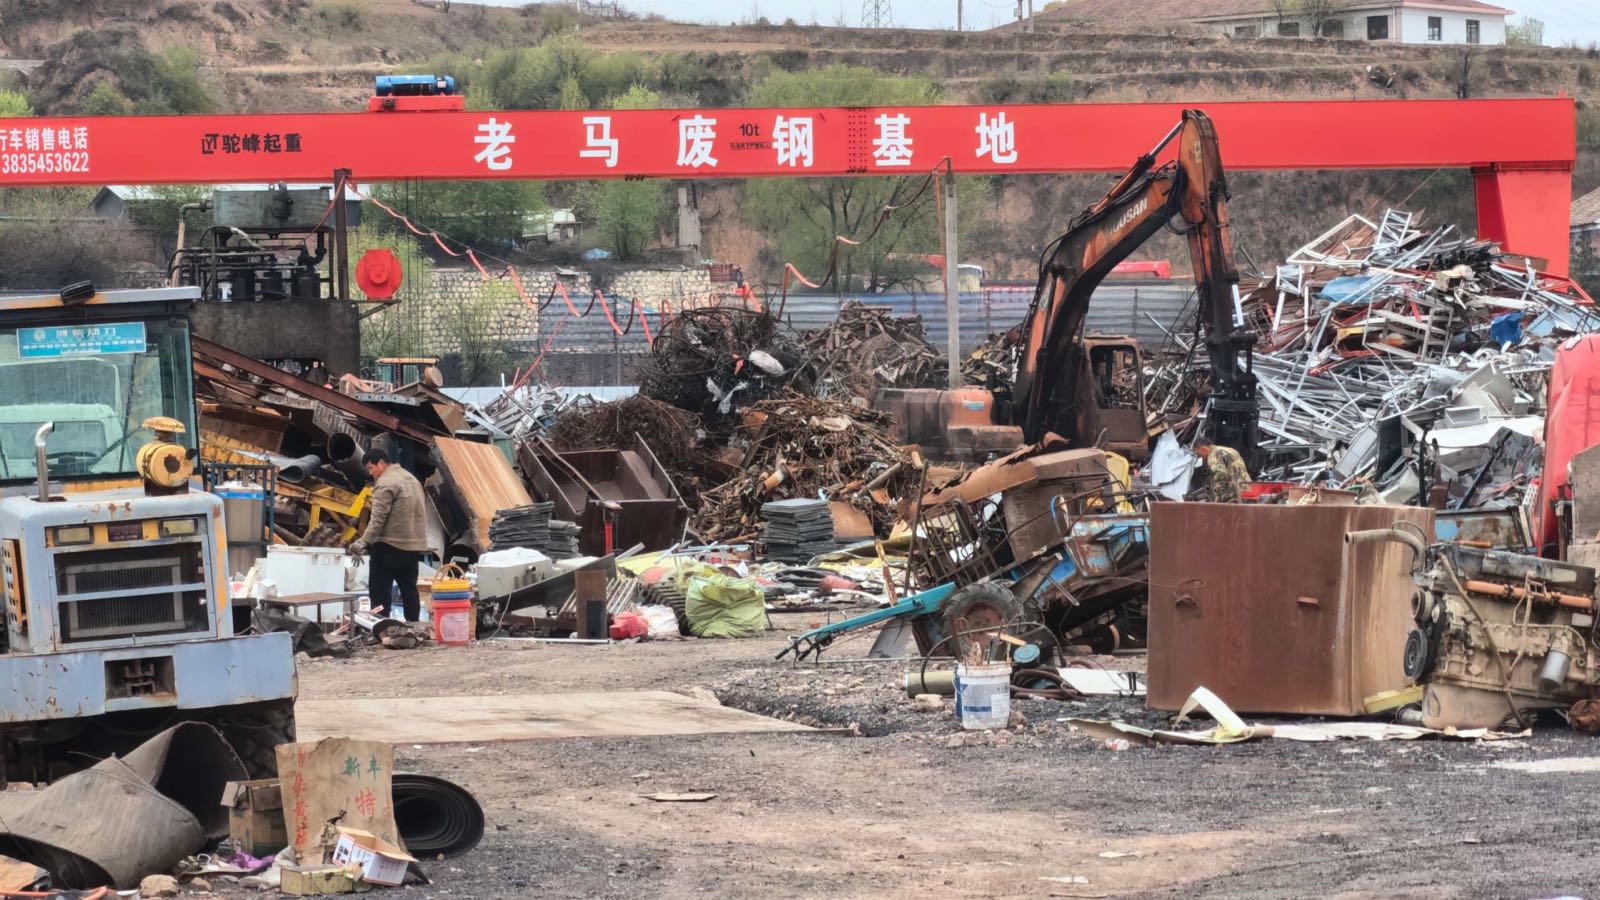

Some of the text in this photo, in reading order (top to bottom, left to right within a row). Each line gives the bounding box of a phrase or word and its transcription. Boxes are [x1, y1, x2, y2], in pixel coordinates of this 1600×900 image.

[739, 123, 760, 136] 10t
[222, 133, 302, 154] 驼峰起重
[474, 112, 1018, 170] 老马废钢基地
